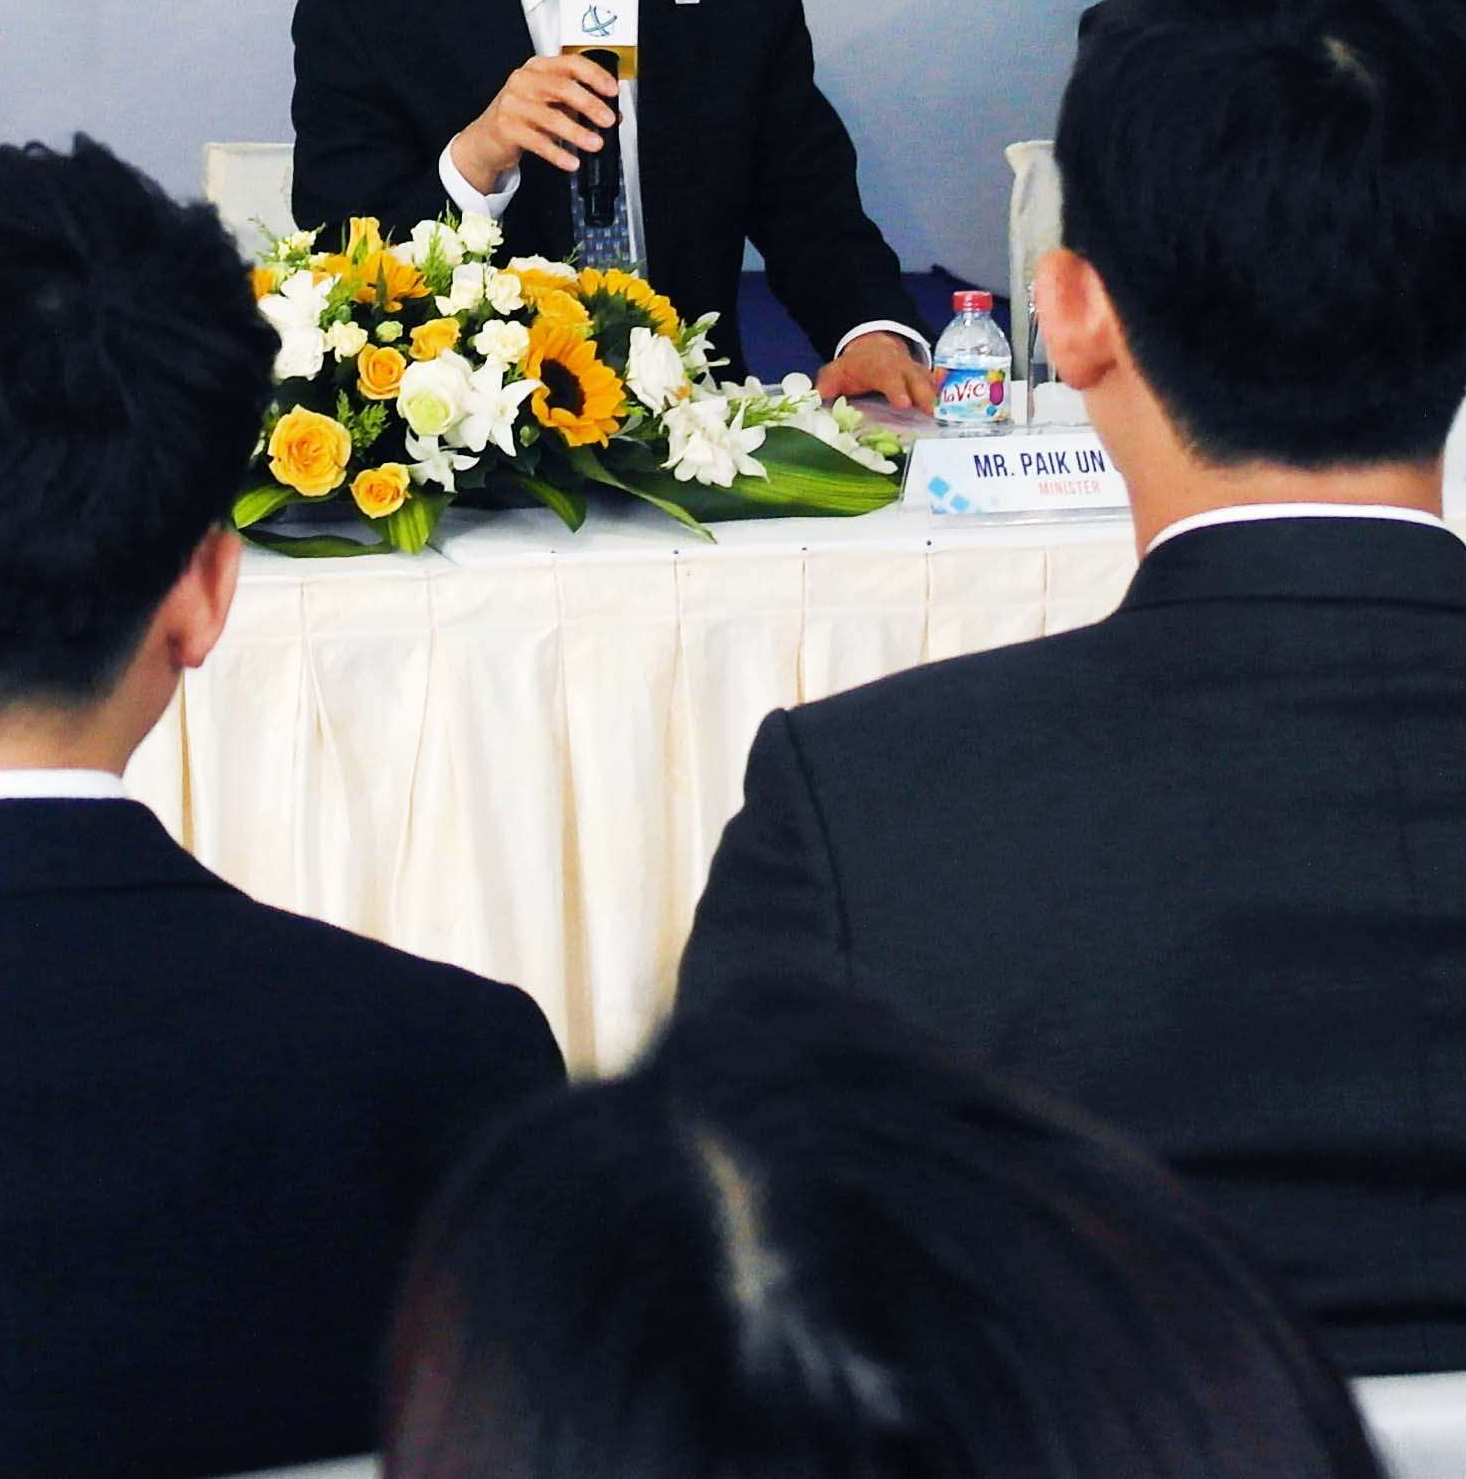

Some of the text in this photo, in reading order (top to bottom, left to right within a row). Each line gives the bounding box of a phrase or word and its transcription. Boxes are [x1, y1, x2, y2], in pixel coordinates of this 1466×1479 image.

[974, 449, 1106, 478] MR. PAIK UN
[1038, 480, 1101, 496] MINISTER
